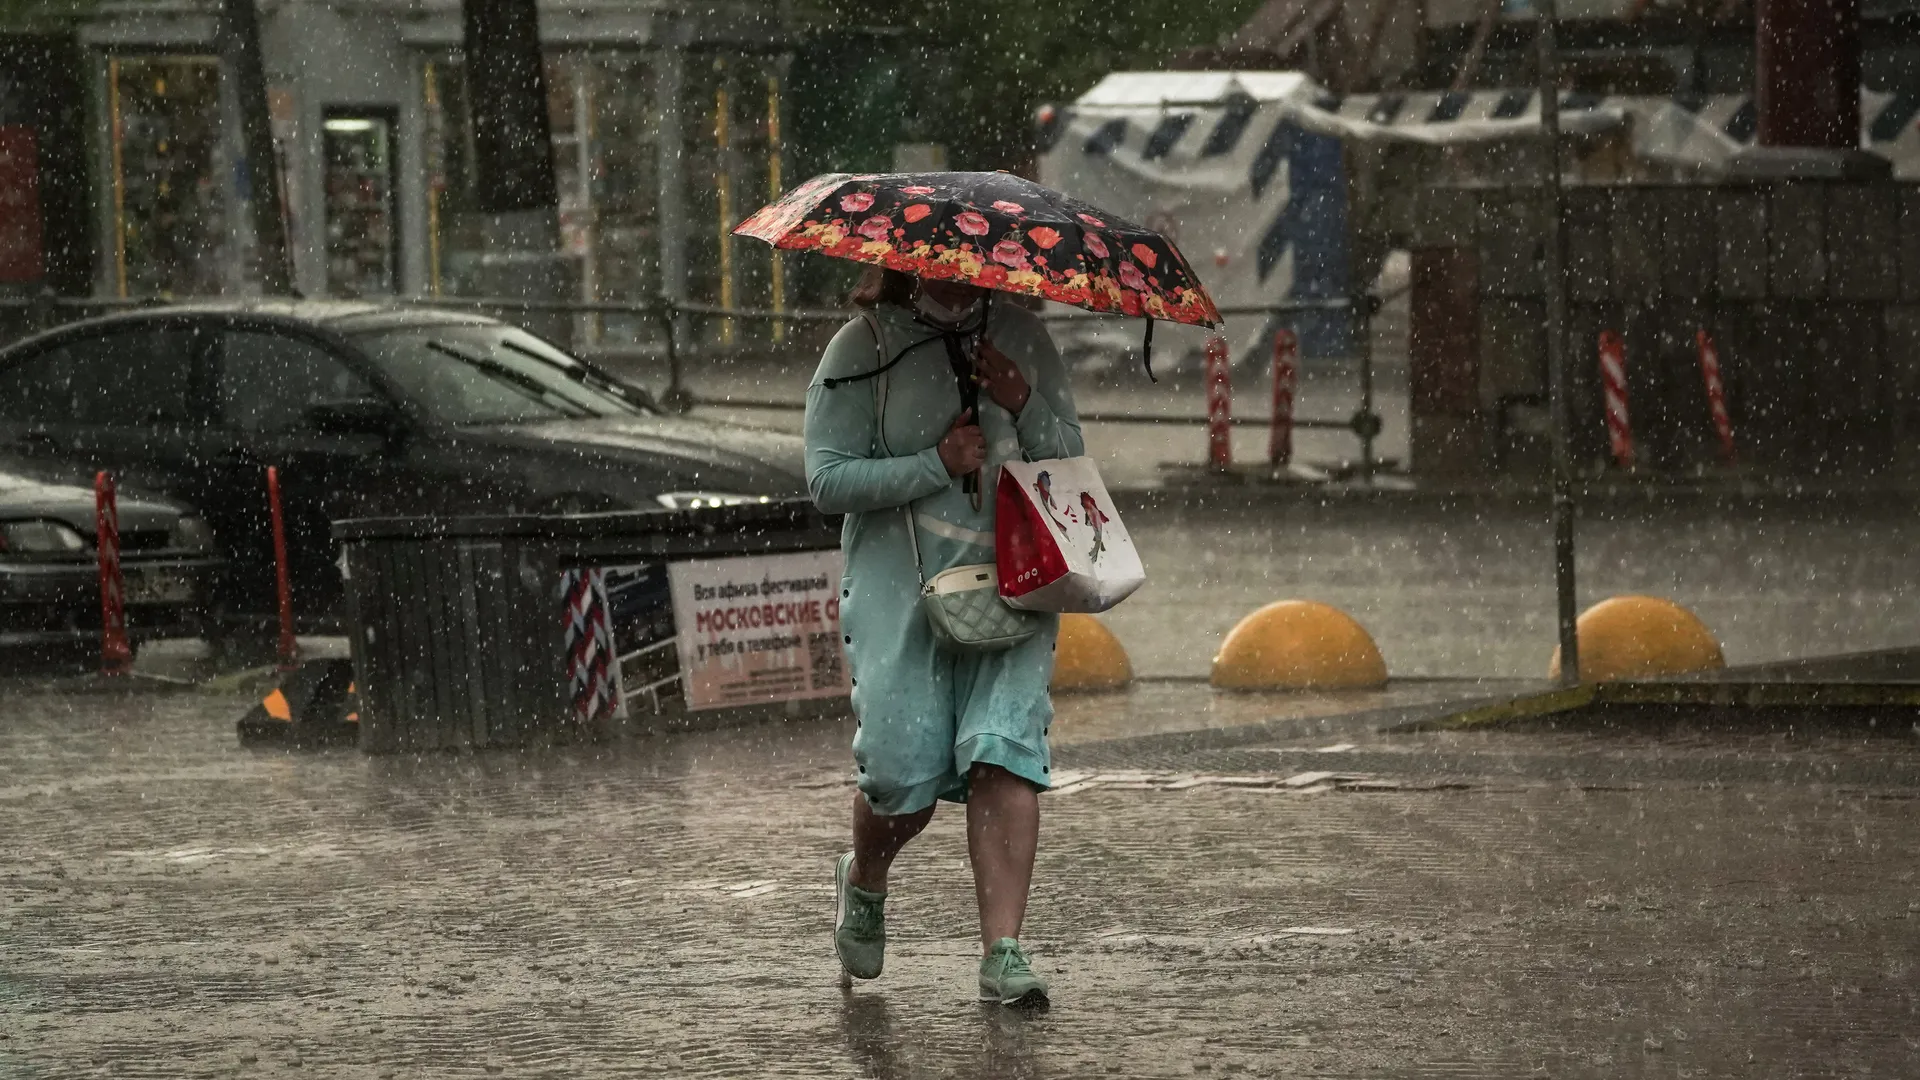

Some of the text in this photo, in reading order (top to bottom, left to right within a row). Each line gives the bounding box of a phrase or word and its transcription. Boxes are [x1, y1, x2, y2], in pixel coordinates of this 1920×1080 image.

[694, 584, 715, 600] Вся
[718, 580, 758, 601] афиша
[695, 598, 839, 633] МОСКОВСКИЕ С
